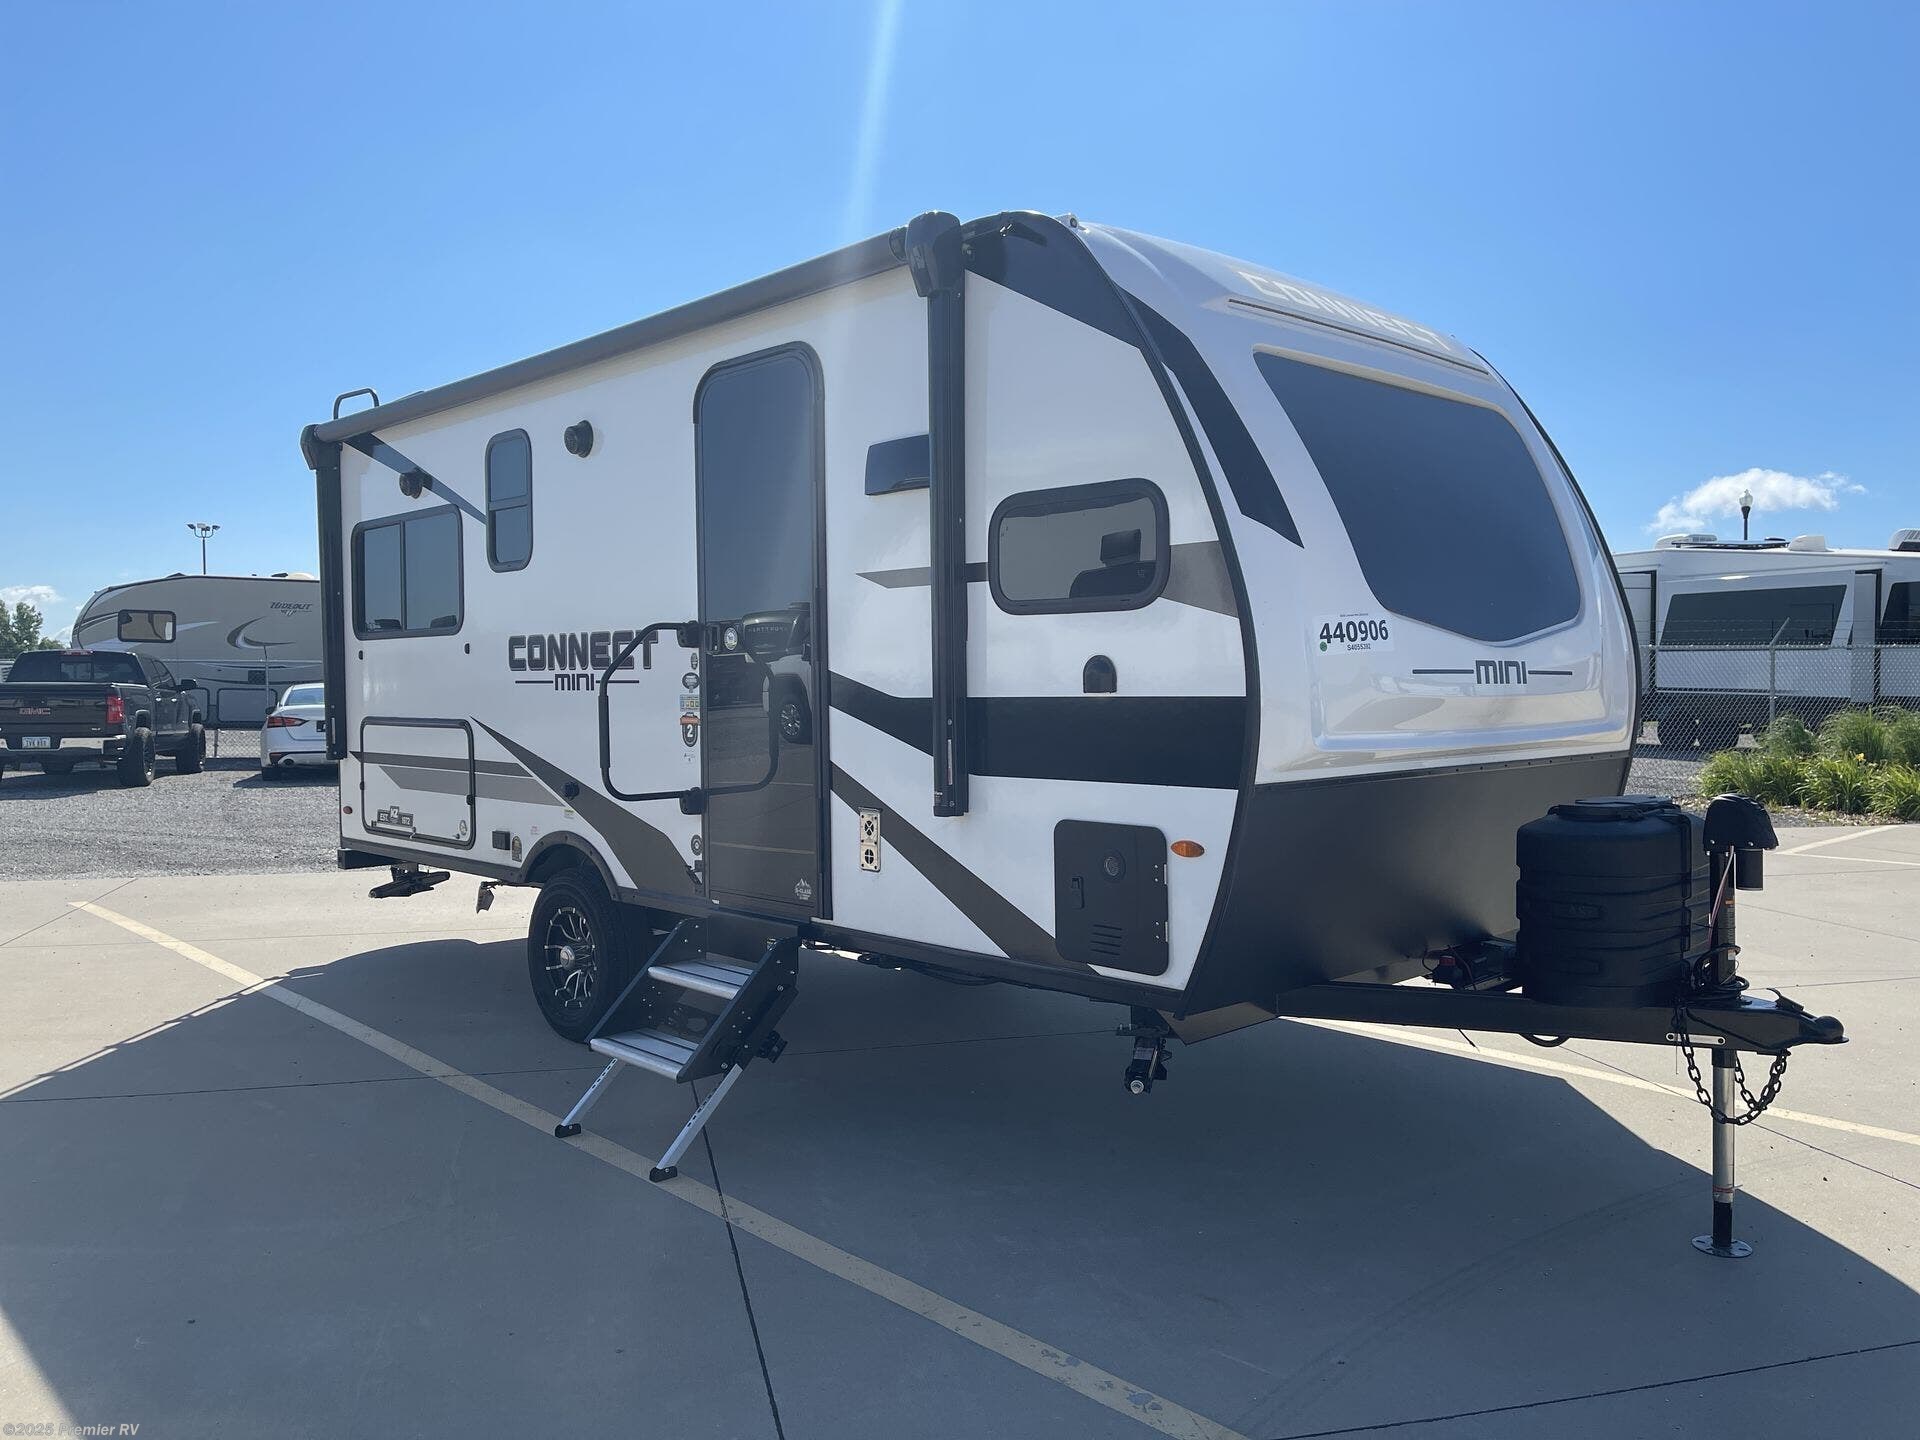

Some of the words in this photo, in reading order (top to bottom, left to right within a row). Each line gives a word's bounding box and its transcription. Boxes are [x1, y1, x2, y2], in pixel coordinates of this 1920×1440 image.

[1238, 270, 1452, 351] CONNECT
[1319, 619, 1390, 645] 440906
[508, 630, 659, 671] CONNECT
[19, 707, 51, 716] GMC
[687, 724, 694, 738] 2
